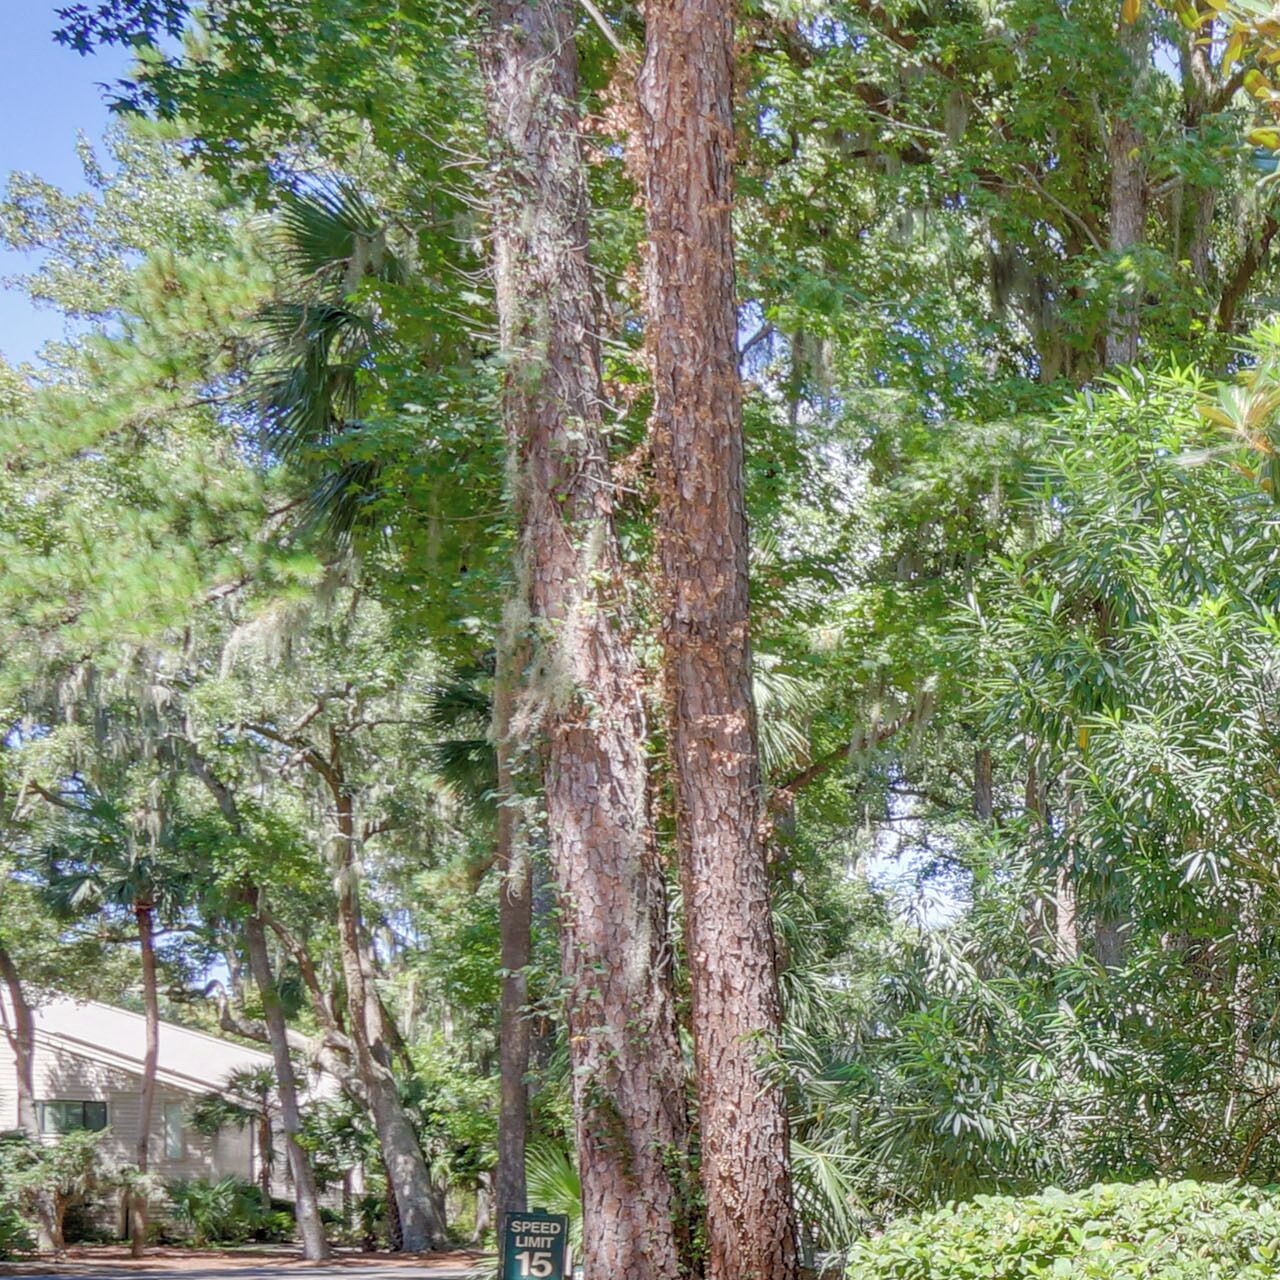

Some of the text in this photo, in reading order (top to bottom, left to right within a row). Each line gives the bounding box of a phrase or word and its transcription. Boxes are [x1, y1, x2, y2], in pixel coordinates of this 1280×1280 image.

[511, 1220, 561, 1234] SPEED
[515, 1235, 555, 1248] LIMIT
[514, 1250, 553, 1278] 15
